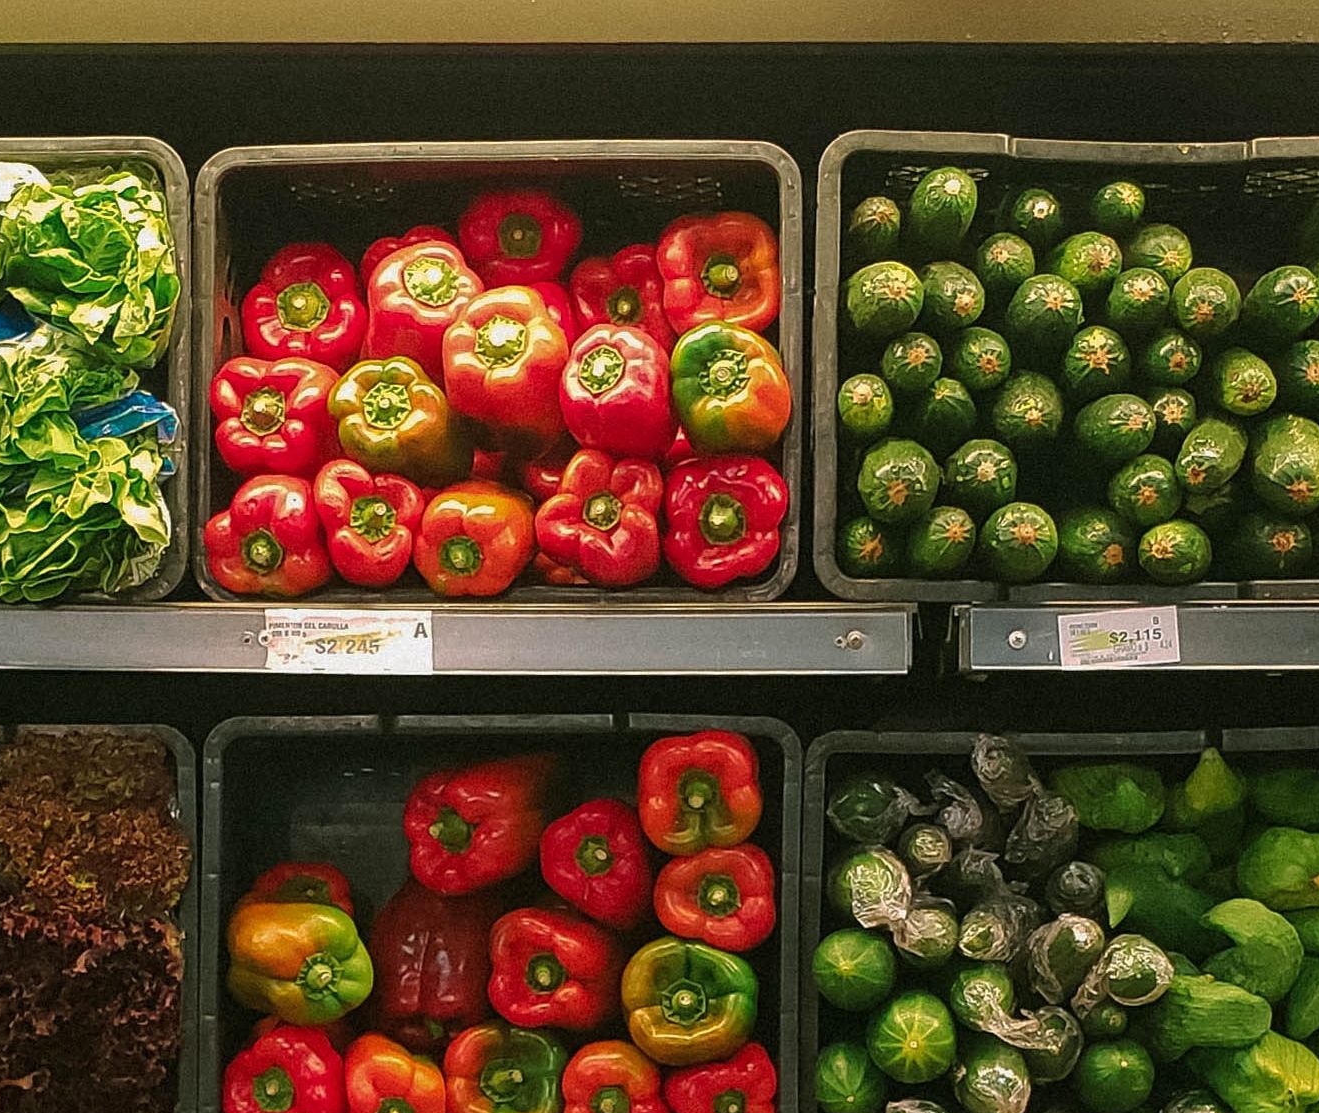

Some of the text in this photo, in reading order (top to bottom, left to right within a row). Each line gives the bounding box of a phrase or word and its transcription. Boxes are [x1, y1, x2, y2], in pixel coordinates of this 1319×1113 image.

[414, 622, 428, 638] A
[1109, 627, 1162, 644] $2,115
[314, 639, 380, 655] $2245
